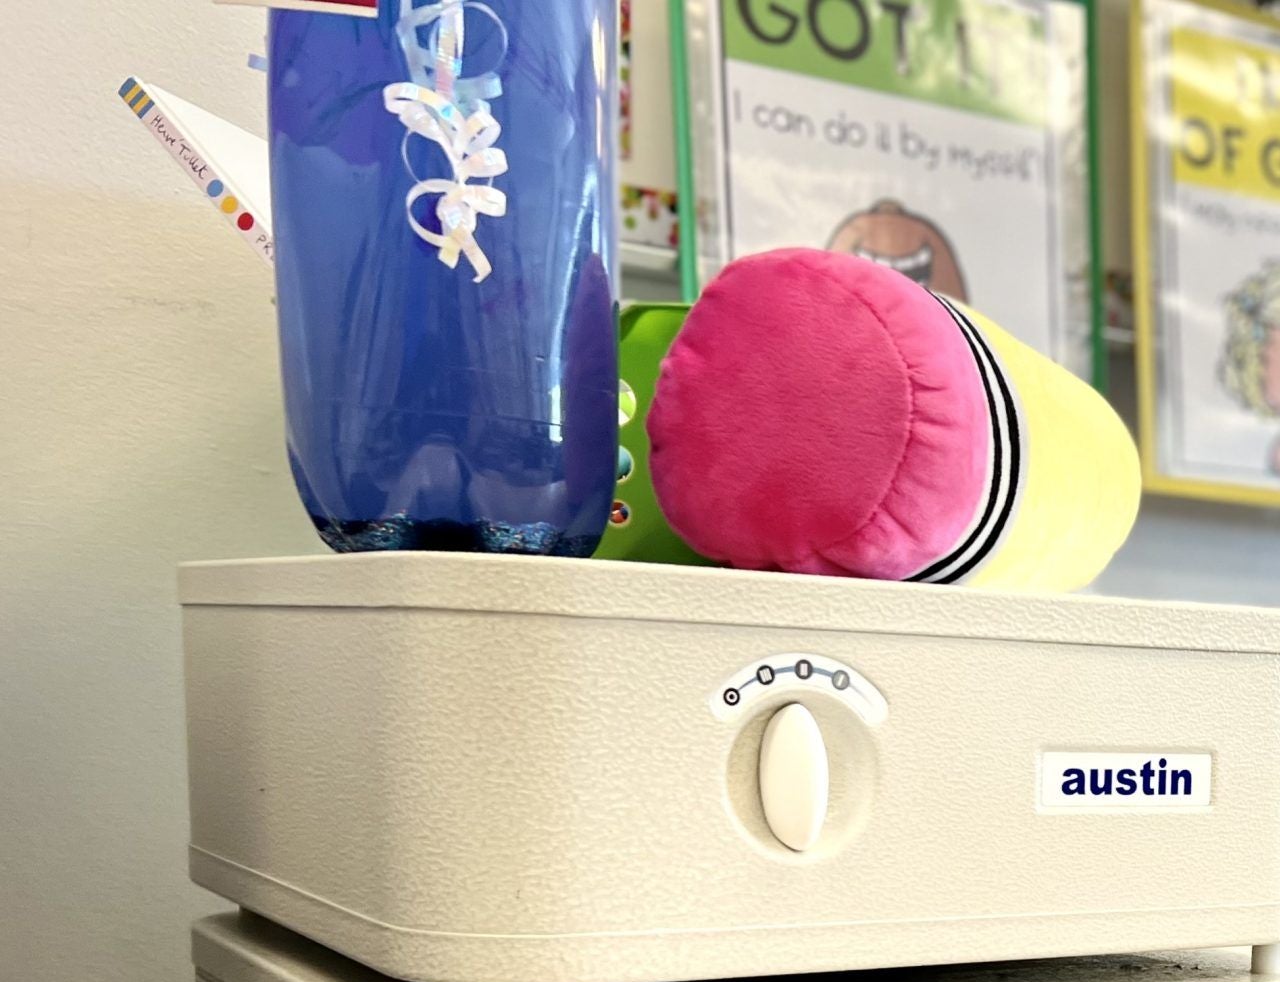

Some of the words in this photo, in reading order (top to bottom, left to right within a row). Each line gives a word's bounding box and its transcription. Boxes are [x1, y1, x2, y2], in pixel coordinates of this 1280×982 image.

[738, 0, 913, 76] GOT
[752, 104, 815, 138] can
[823, 110, 868, 148] do
[901, 124, 940, 171] by
[1180, 116, 1244, 176] OF
[1061, 757, 1192, 796] austin
